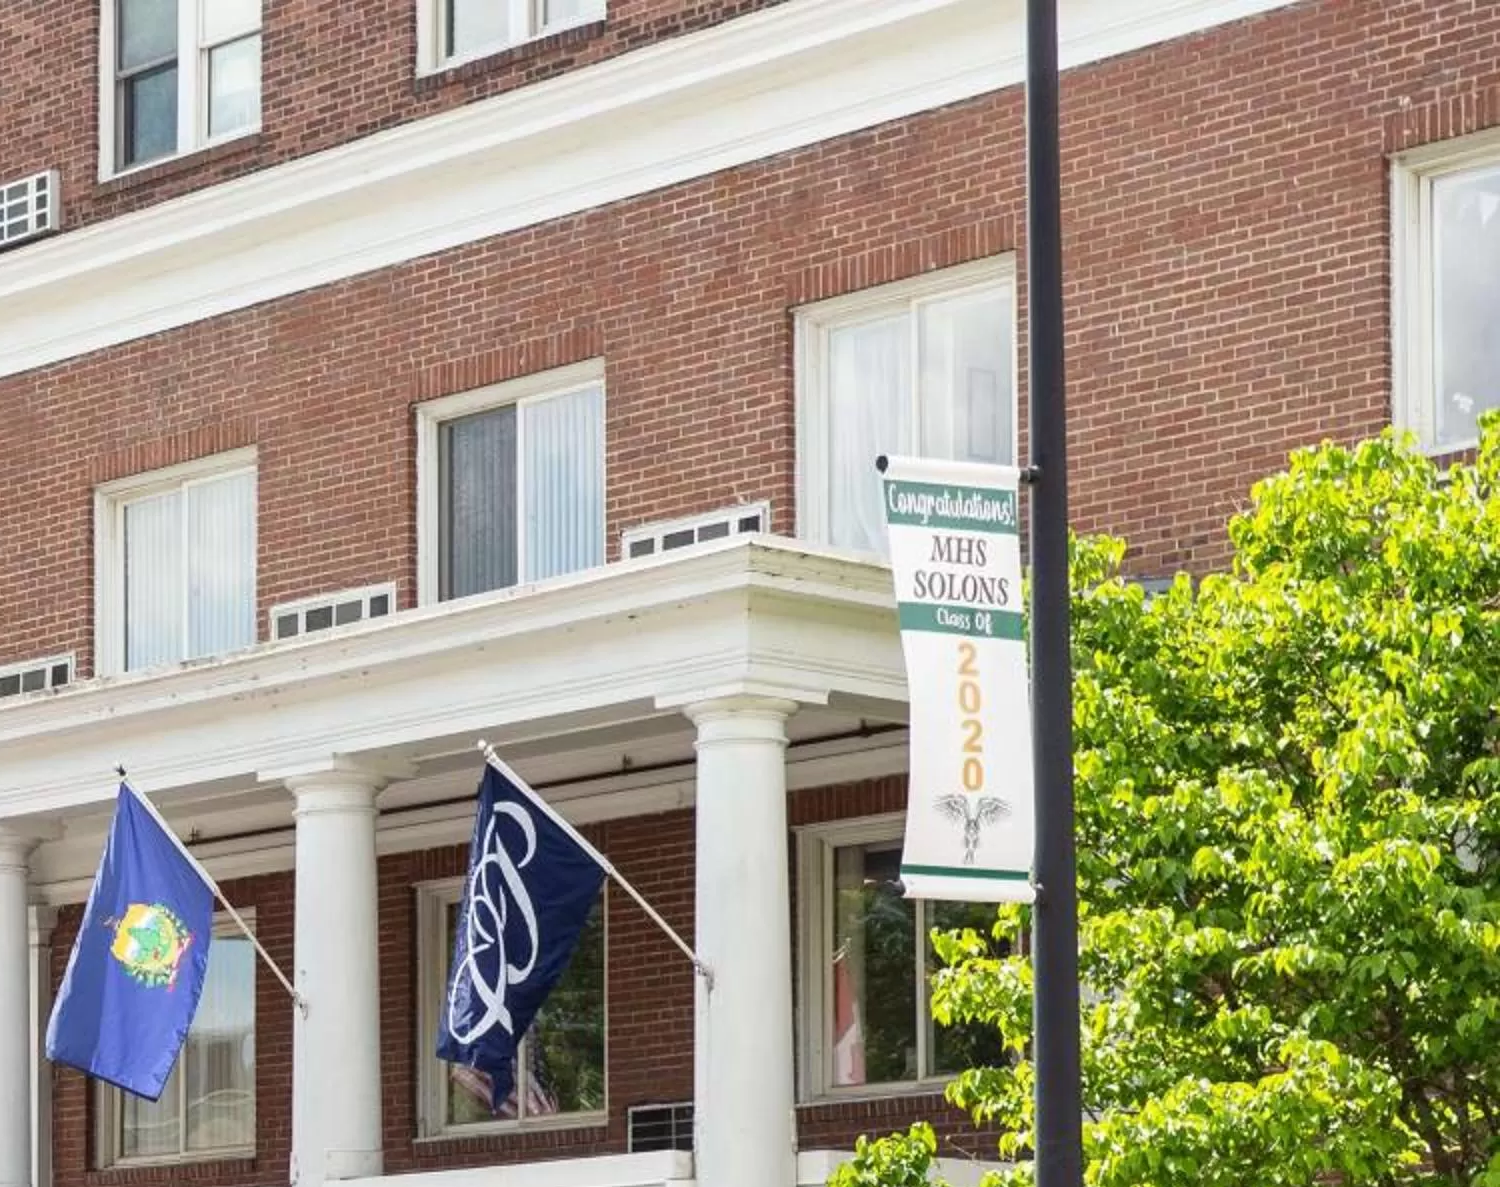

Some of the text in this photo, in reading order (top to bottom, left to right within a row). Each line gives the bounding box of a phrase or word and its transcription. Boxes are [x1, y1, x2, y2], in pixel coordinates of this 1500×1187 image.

[888, 483, 1015, 526] Congratulations!
[930, 535, 987, 567] MHS
[913, 570, 1009, 606] SOLONS
[936, 607, 971, 630] Class
[957, 641, 984, 791] 2020
